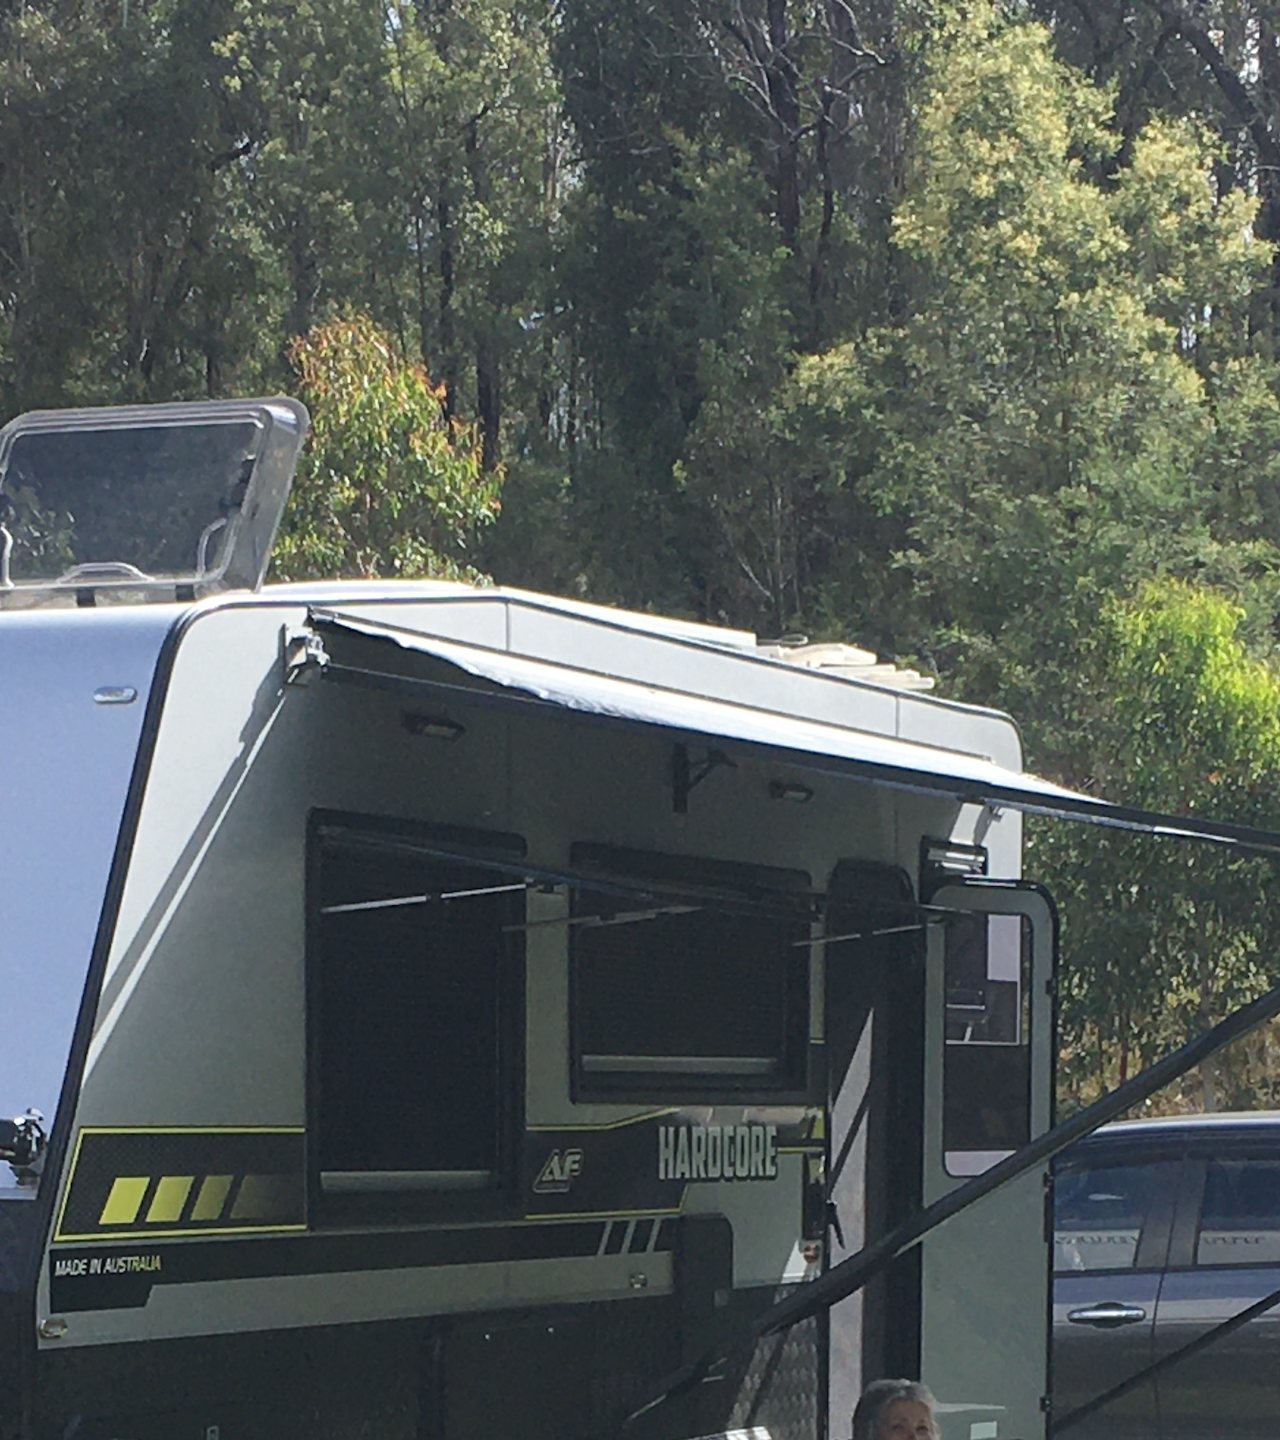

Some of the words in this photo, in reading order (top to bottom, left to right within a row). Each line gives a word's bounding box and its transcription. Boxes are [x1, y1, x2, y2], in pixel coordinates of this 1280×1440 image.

[659, 1125, 777, 1181] HARDCORE
[55, 1258, 88, 1277] MADE
[90, 1257, 102, 1274] IN
[104, 1255, 162, 1273] AUSTRALIA
